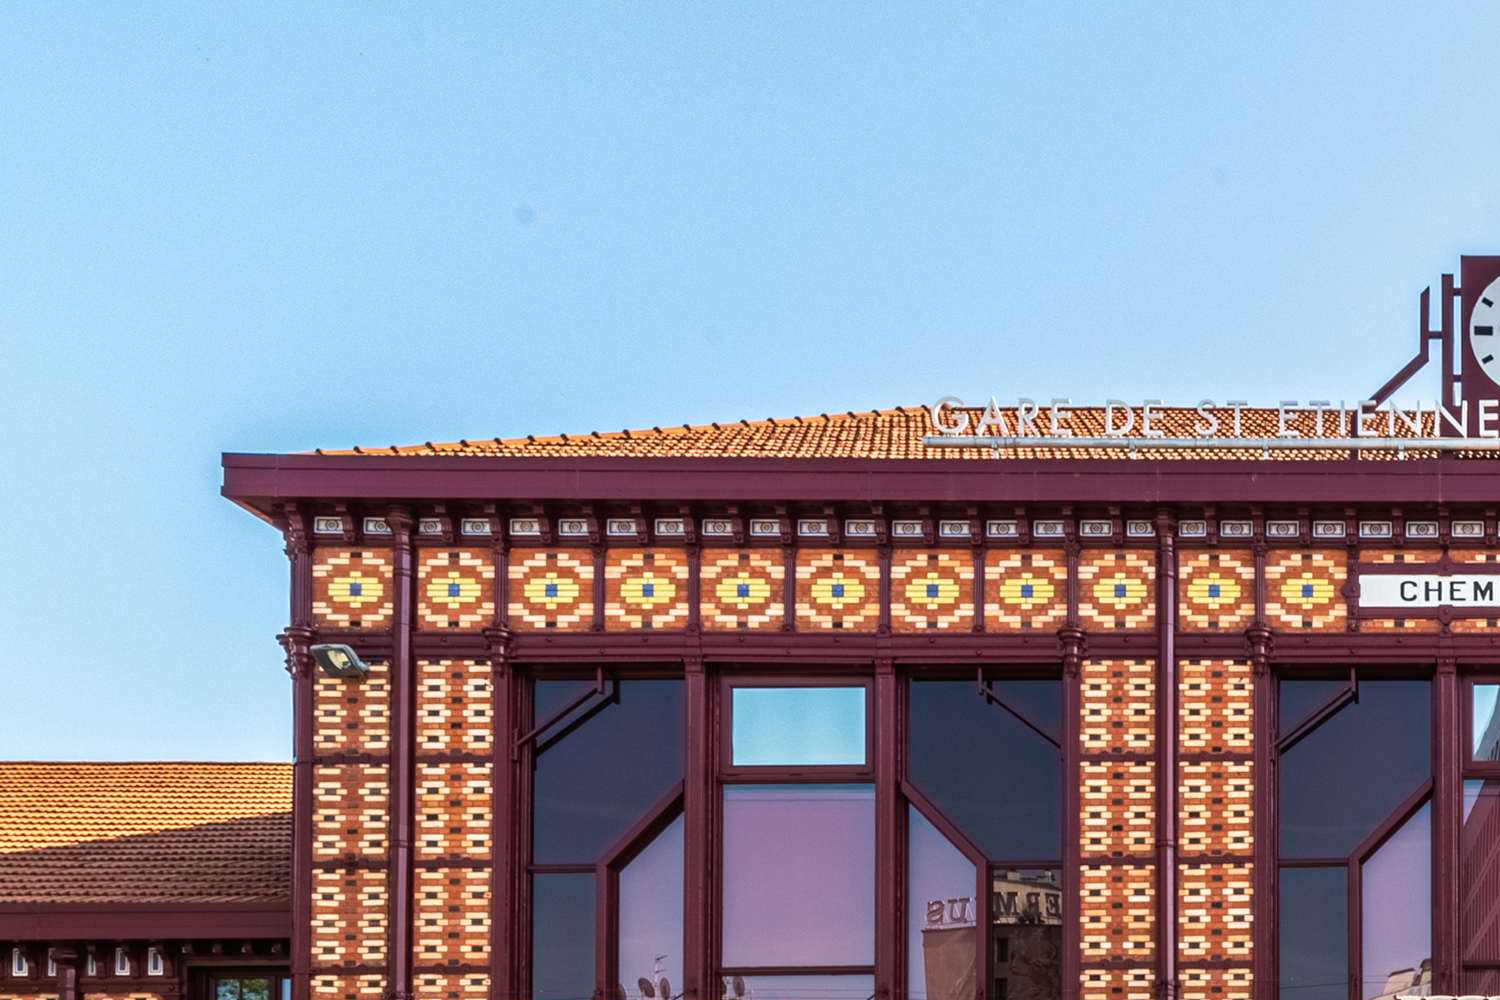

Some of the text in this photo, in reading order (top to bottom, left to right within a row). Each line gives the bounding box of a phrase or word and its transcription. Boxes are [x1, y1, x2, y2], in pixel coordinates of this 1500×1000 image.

[931, 395, 1073, 438] GARE
[1105, 397, 1165, 438] DE
[1194, 399, 1249, 438] ST
[1278, 398, 1500, 439] ETIENNE
